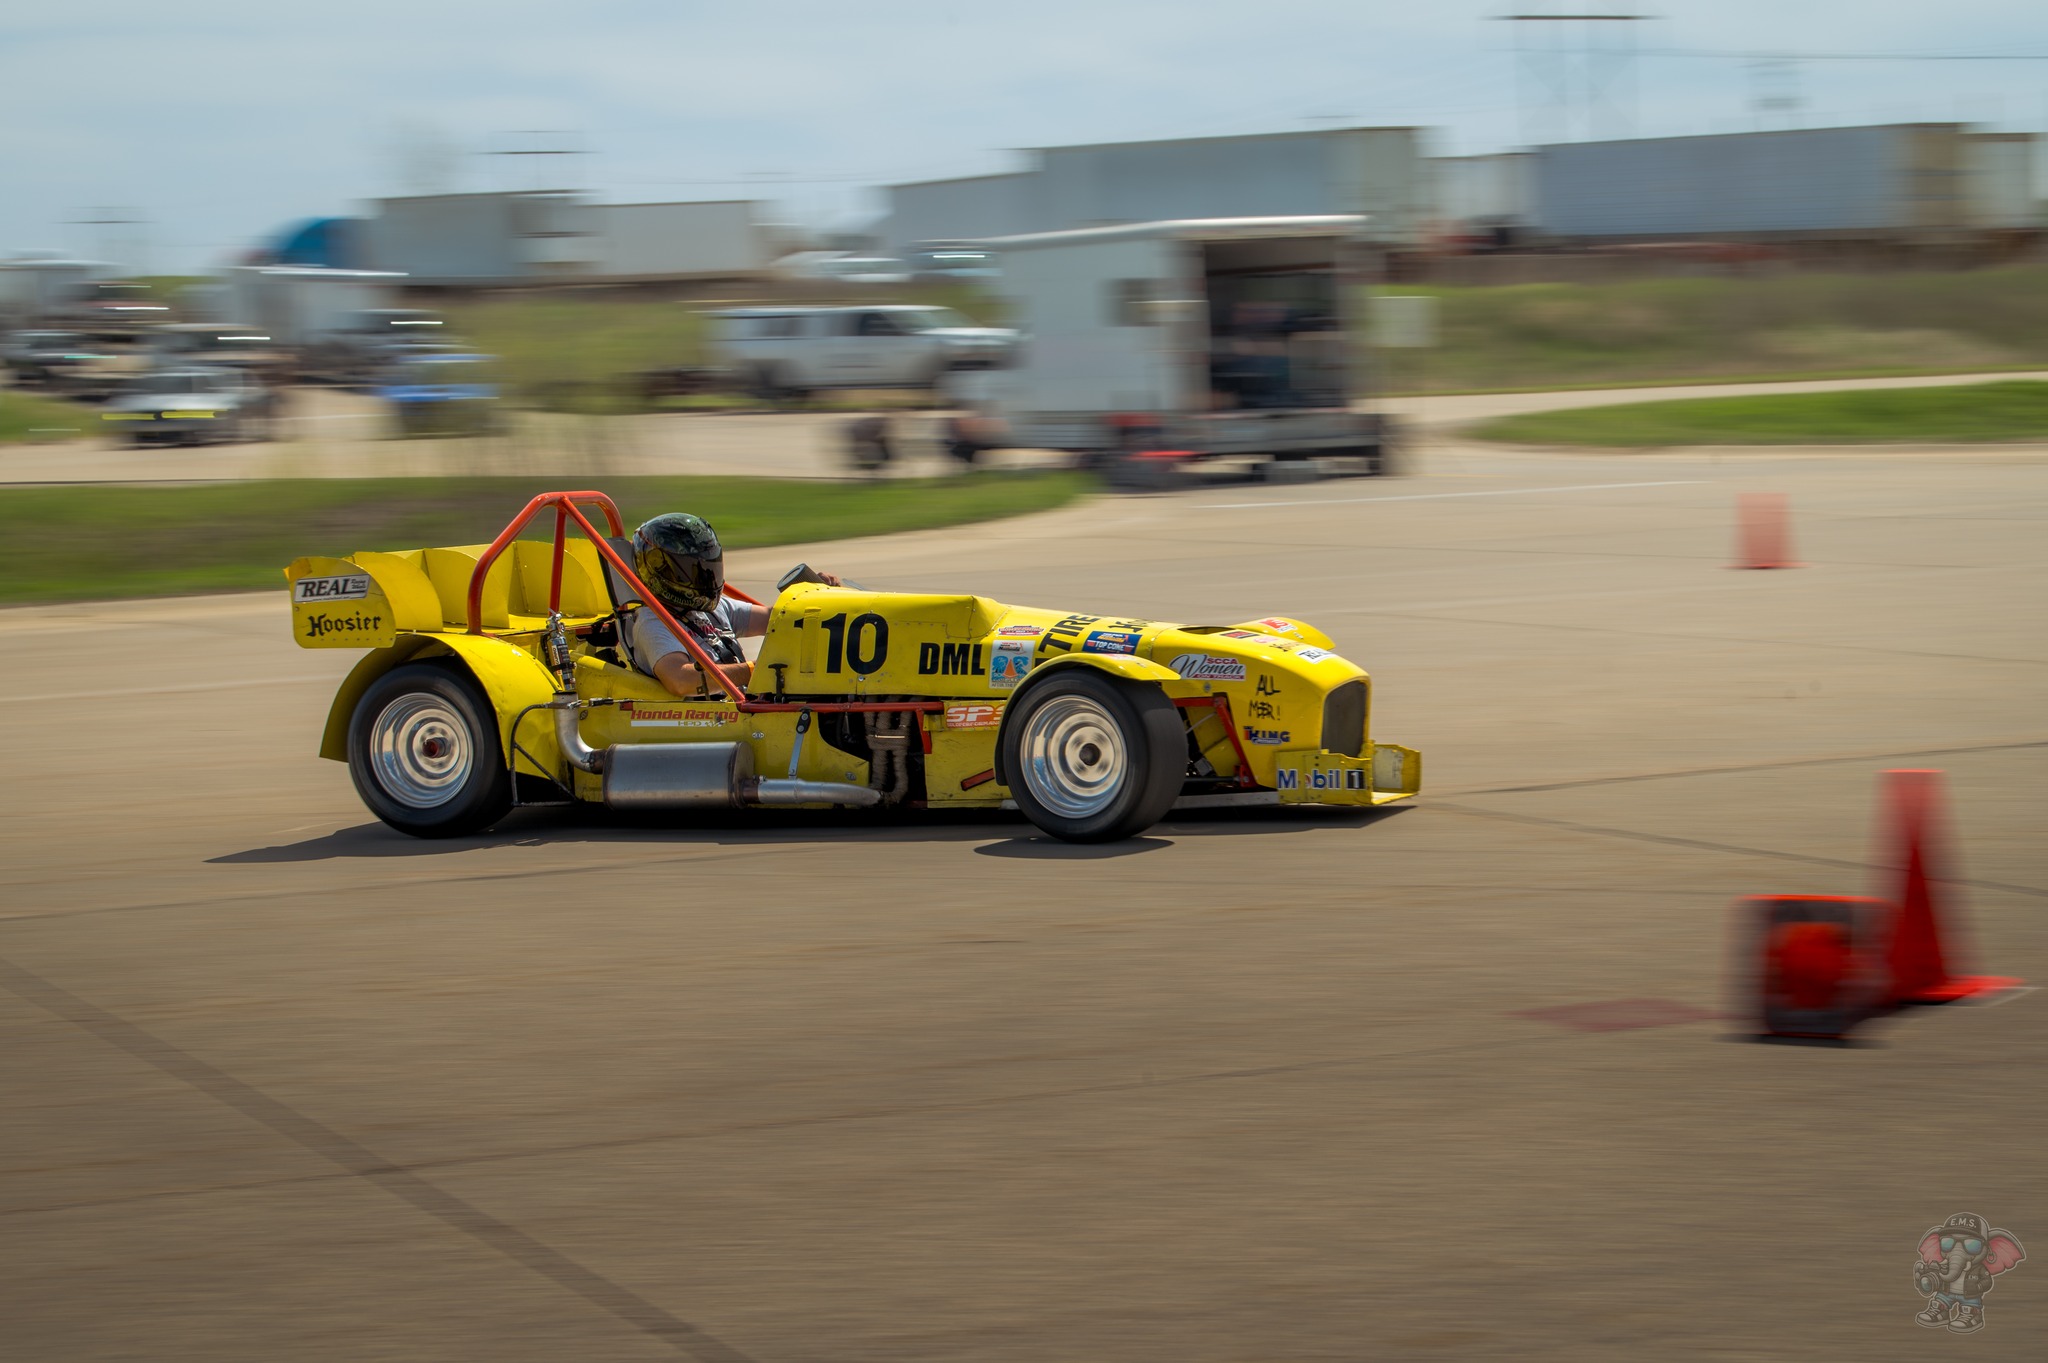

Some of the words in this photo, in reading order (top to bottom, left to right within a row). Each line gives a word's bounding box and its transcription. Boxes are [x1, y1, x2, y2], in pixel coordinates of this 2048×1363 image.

[297, 578, 365, 597] REAL
[306, 611, 381, 636] Hoosier
[1038, 615, 1101, 653] TIRE
[821, 613, 889, 675] 10
[1107, 642, 1125, 651] CONE
[918, 642, 985, 675] DML
[1169, 654, 1244, 678] Women
[1207, 657, 1239, 665] SCCA
[1256, 675, 1281, 696] ALL
[631, 709, 682, 720] Honda
[685, 709, 739, 723] Racing
